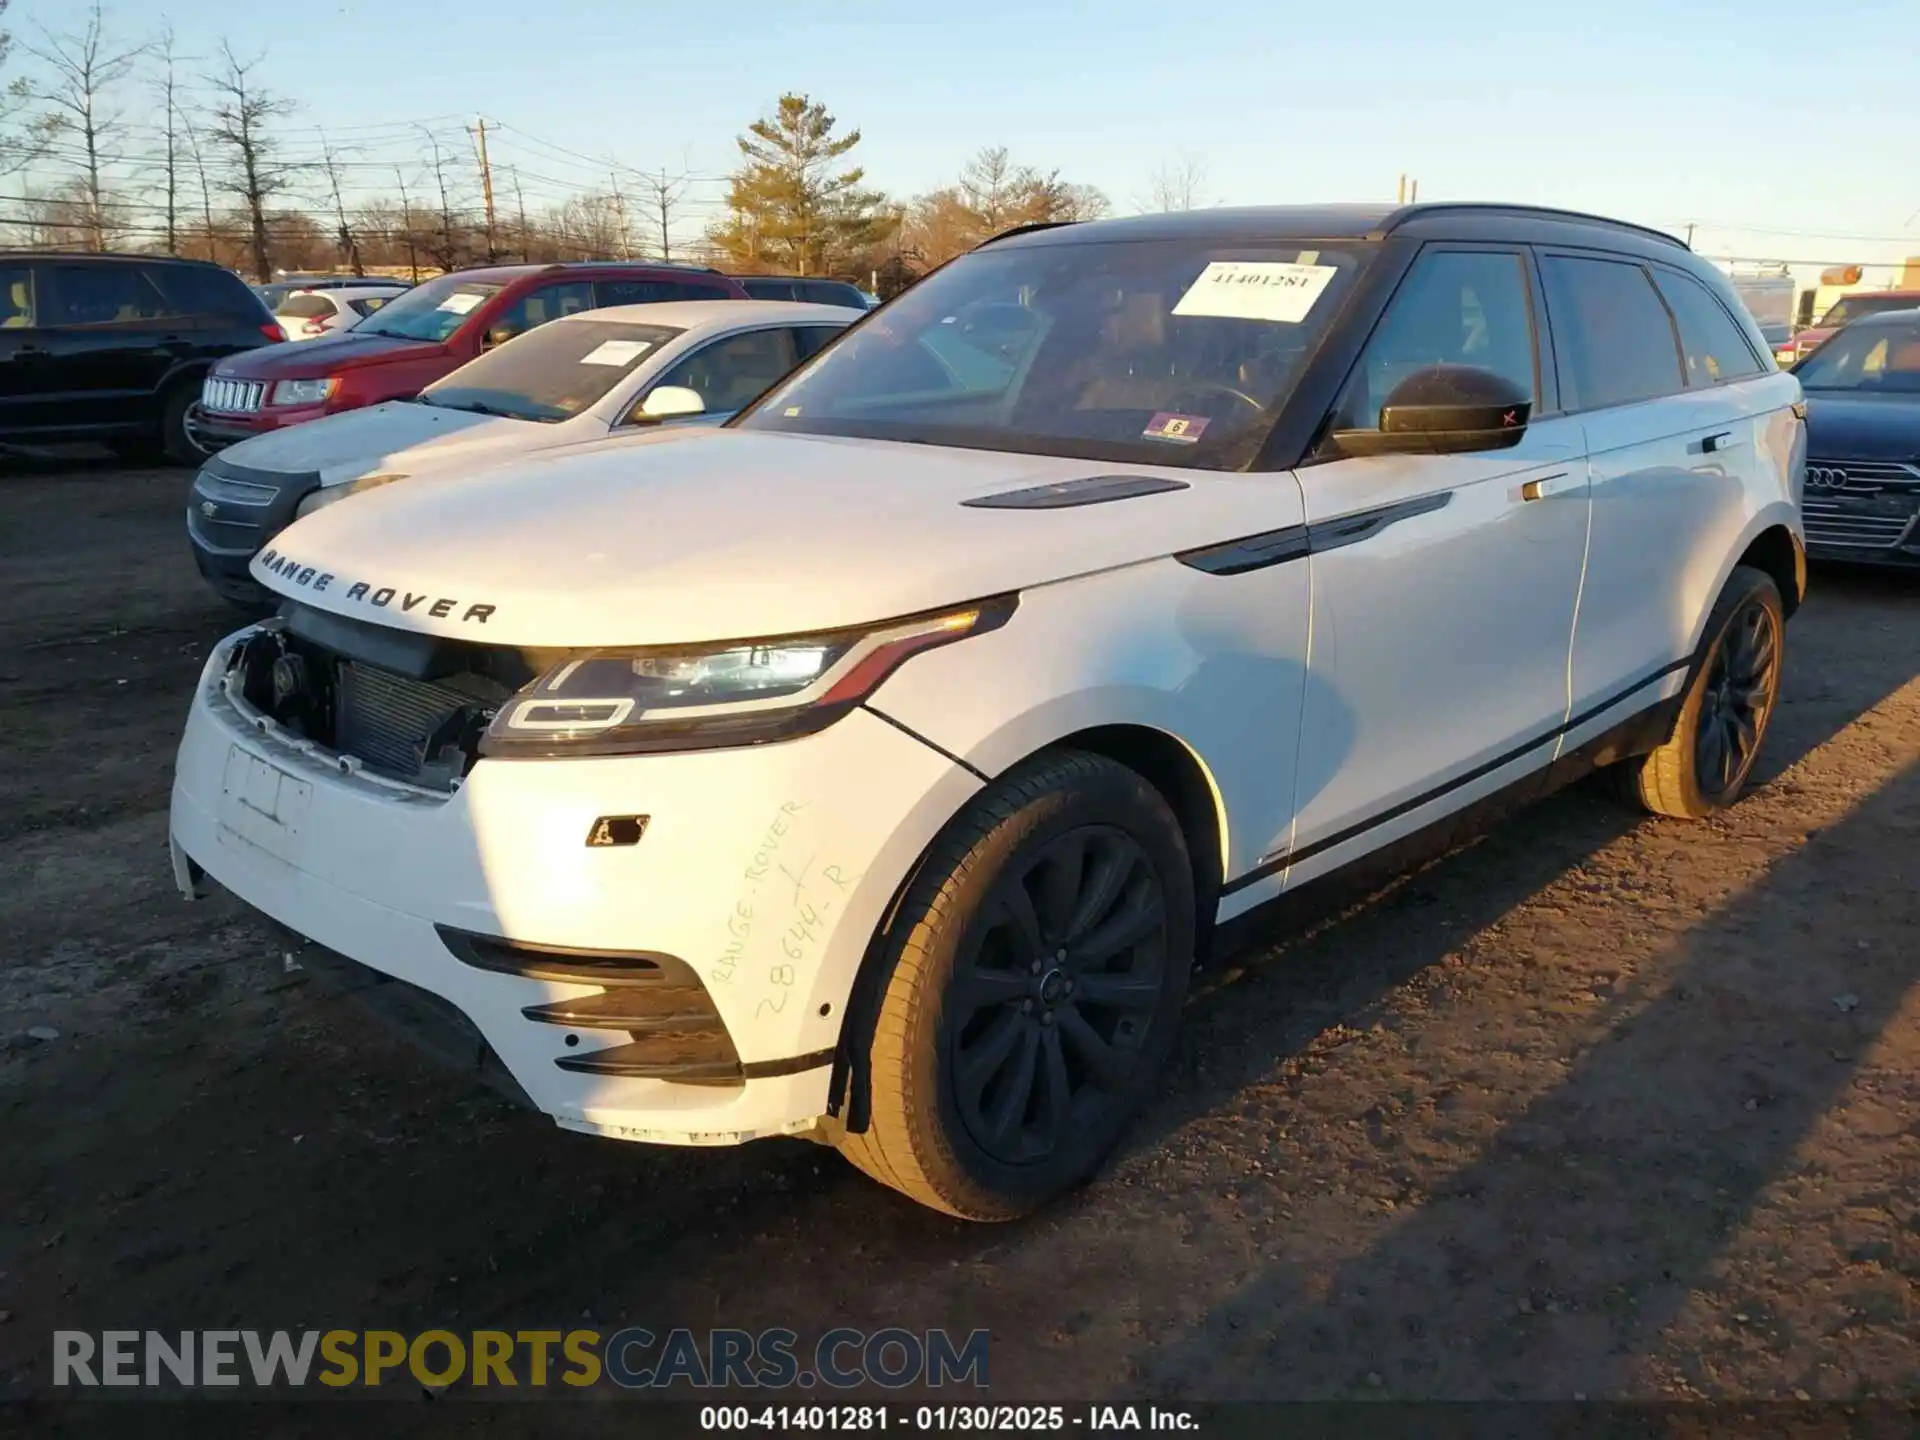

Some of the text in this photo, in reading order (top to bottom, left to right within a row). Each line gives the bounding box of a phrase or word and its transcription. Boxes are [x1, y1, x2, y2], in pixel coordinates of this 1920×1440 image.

[1211, 273, 1309, 288] 41401281
[261, 549, 497, 624] RANGE ROVER
